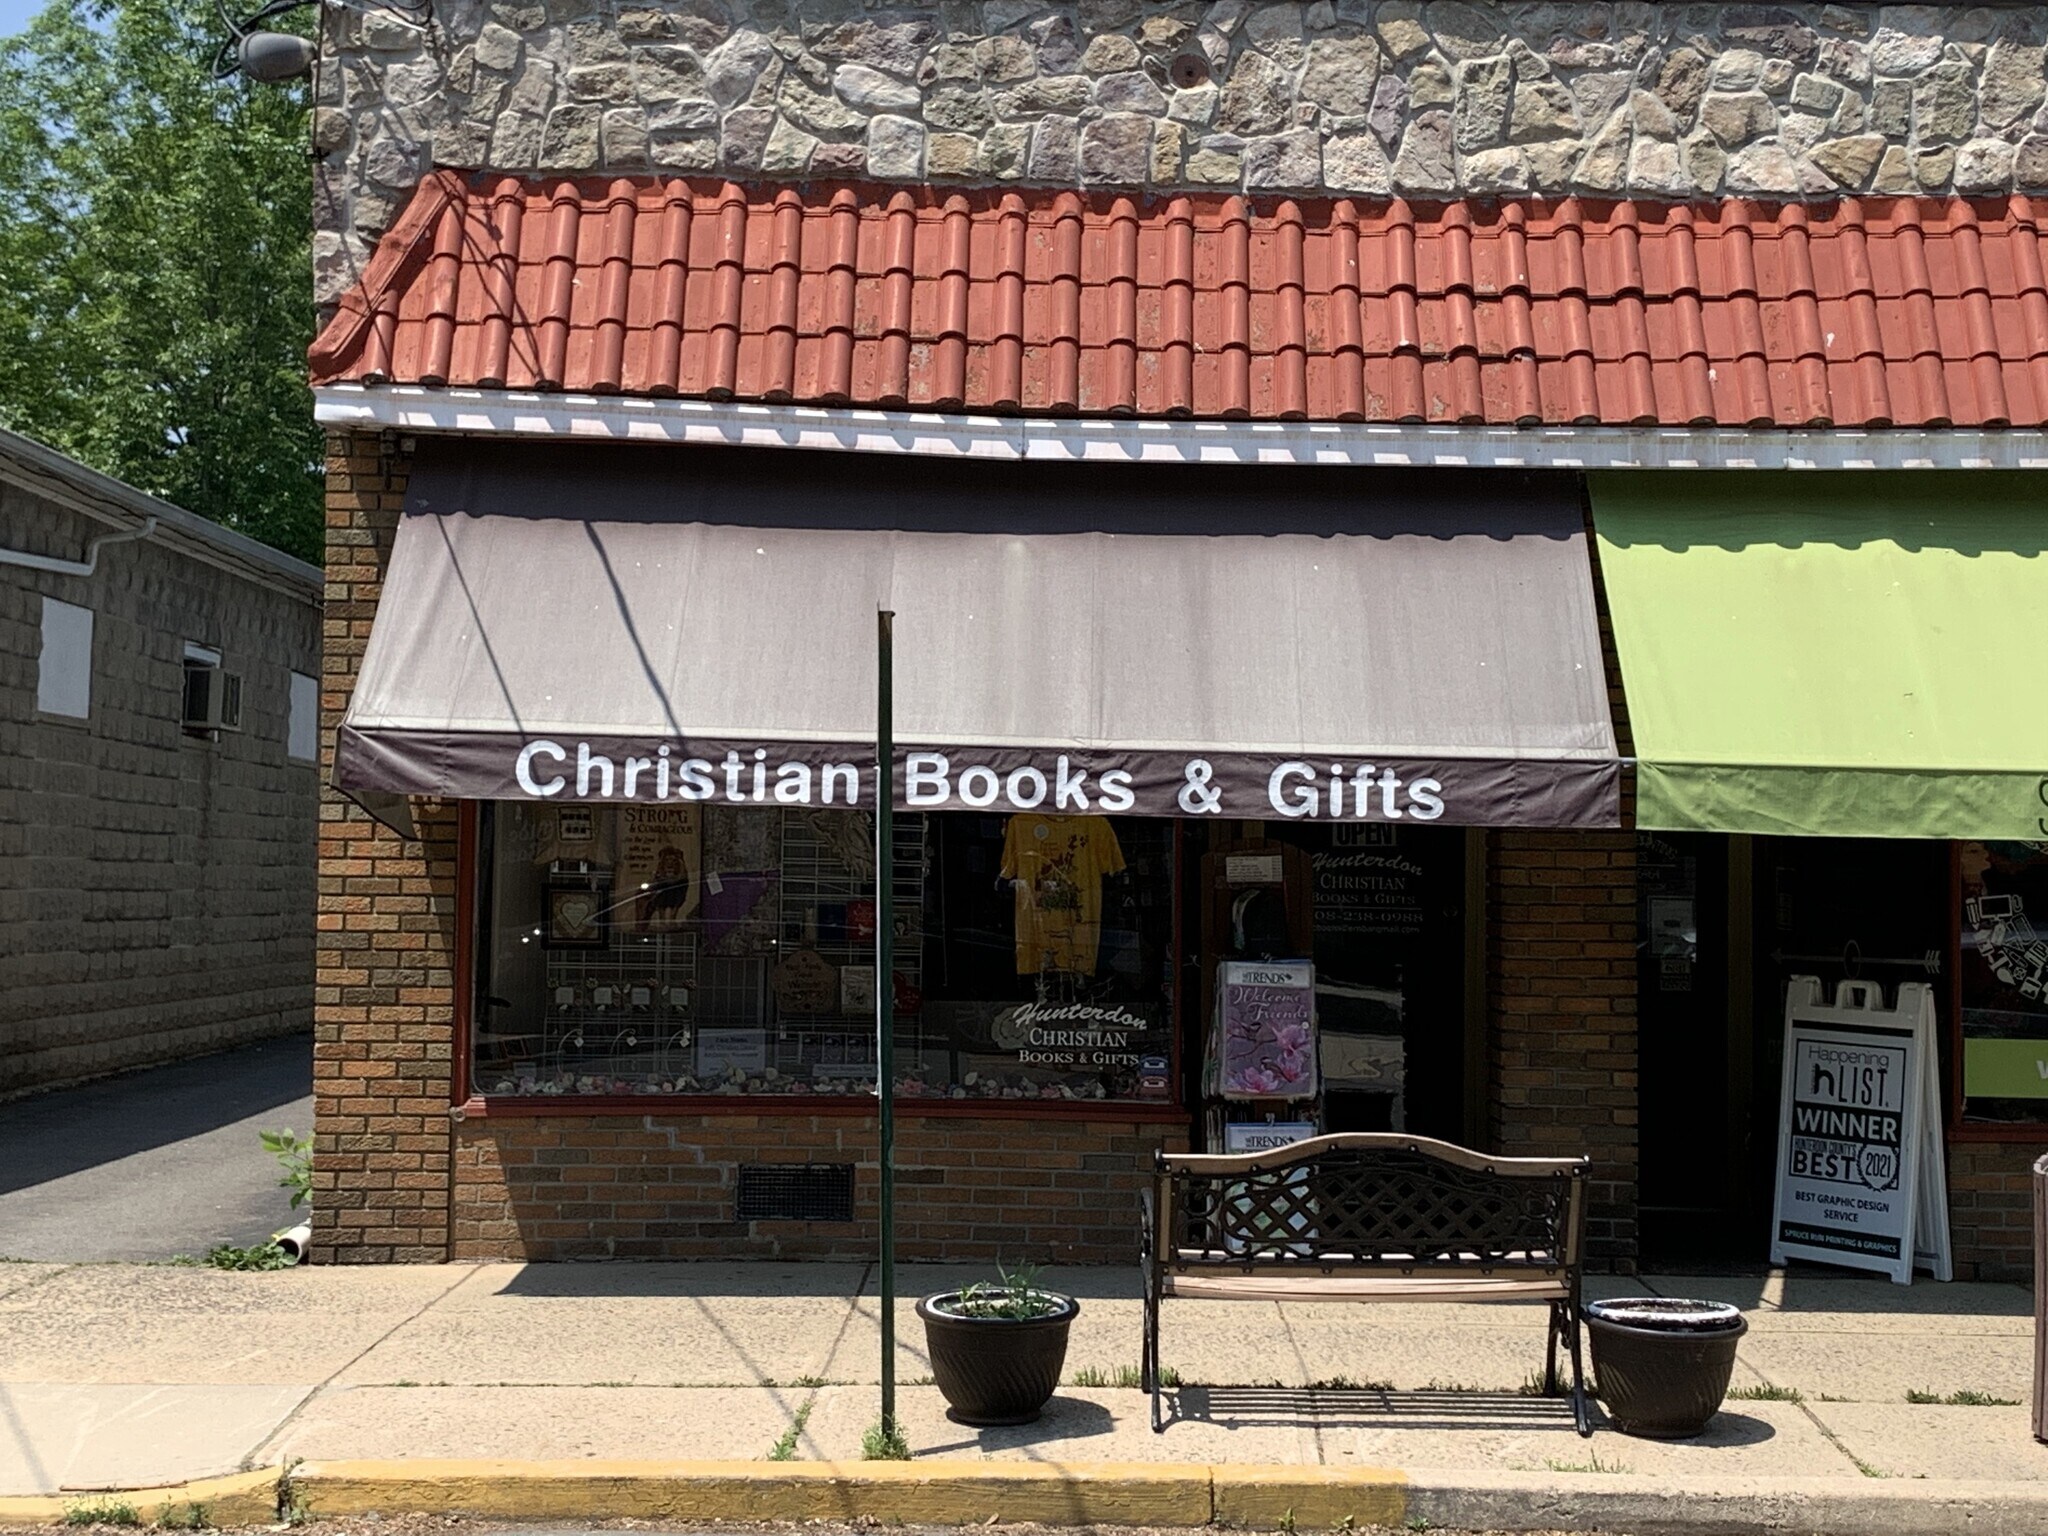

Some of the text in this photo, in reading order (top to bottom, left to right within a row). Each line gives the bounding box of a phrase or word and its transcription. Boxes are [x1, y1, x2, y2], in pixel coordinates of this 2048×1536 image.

[515, 740, 1445, 820] Christian Books & Gifts
[1336, 823, 1393, 845] OPEN
[1312, 852, 1423, 876] Hunterdon
[1320, 873, 1405, 890] CHRISTIAN
[1248, 971, 1286, 984] TRENDS
[1012, 1002, 1148, 1031] Hunterdon
[1029, 1027, 1128, 1047] CHRISTIAN
[1019, 1050, 1074, 1063] BOOKS
[1079, 1053, 1088, 1063] &
[1092, 1052, 1139, 1065] GIFTS
[1809, 1045, 1889, 1068] Happening
[1796, 1107, 1897, 1142] WINNER
[1252, 1136, 1289, 1148] TRENDS
[1793, 1151, 1891, 1180] BEST 2021
[1795, 1191, 1890, 1213] BEST GRAPHIC DESIGN
[1824, 1209, 1859, 1223] SERVICE
[1784, 1228, 1809, 1240] SPRUCE
[1825, 1235, 1857, 1247] PRINTING
[1863, 1240, 1897, 1253] GRAPHICS
